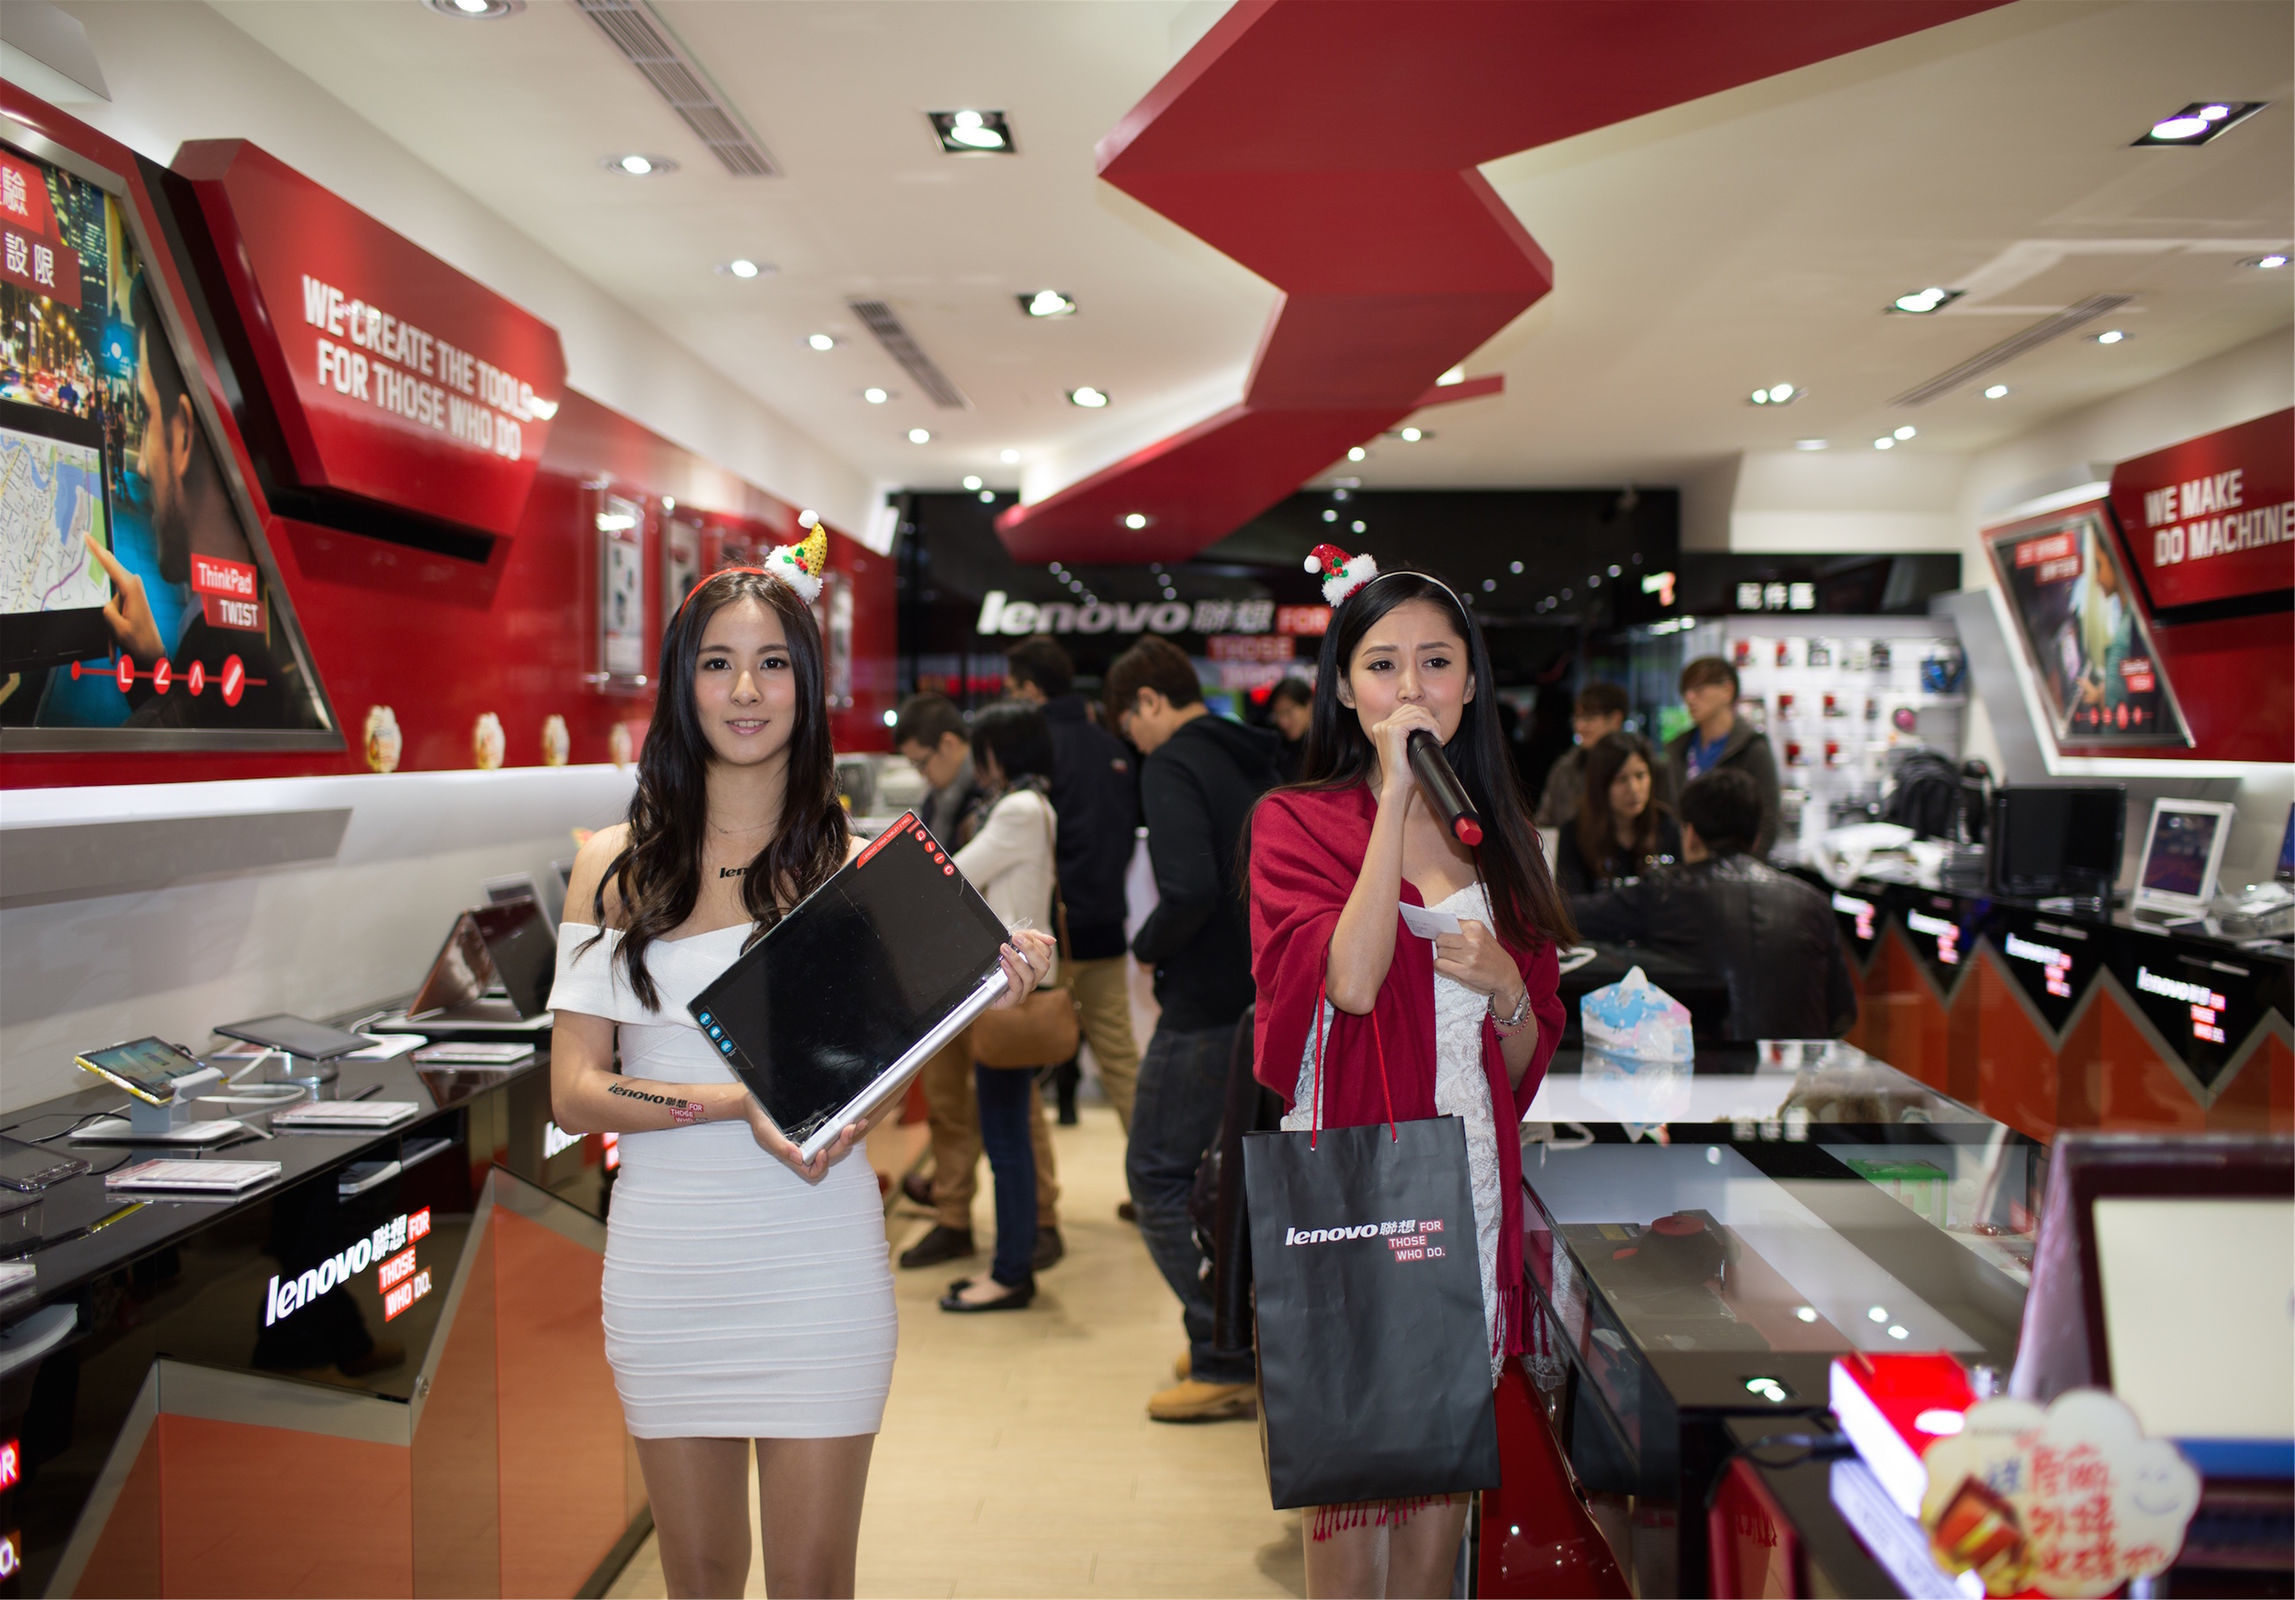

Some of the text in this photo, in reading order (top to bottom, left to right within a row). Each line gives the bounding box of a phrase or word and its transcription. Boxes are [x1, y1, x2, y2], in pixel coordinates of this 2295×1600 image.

[303, 274, 535, 423] WE CREATE THE TOOLS
[318, 338, 522, 461] FOR THOSE WHO DO
[2144, 468, 2243, 528] WE MAKE
[2154, 501, 2295, 568] DO MACHINE
[198, 562, 253, 595] ThinkPad
[220, 600, 259, 627] TWIST
[976, 590, 1192, 635] lenovo
[1278, 607, 1332, 632] FOR
[1211, 637, 1292, 659] THOSE
[608, 1083, 665, 1104] lenovo
[689, 1103, 703, 1111] FOR
[671, 1108, 694, 1117] THOSE
[1285, 1220, 1442, 1246] lenovo 聯想 FOR
[1389, 1236, 1426, 1248] THOSE
[266, 1210, 431, 1327] lenovo 聯想 FOR
[380, 1249, 416, 1288] THOSE
[1396, 1247, 1446, 1261] WHO DO.
[386, 1271, 432, 1316] WHO DO.
